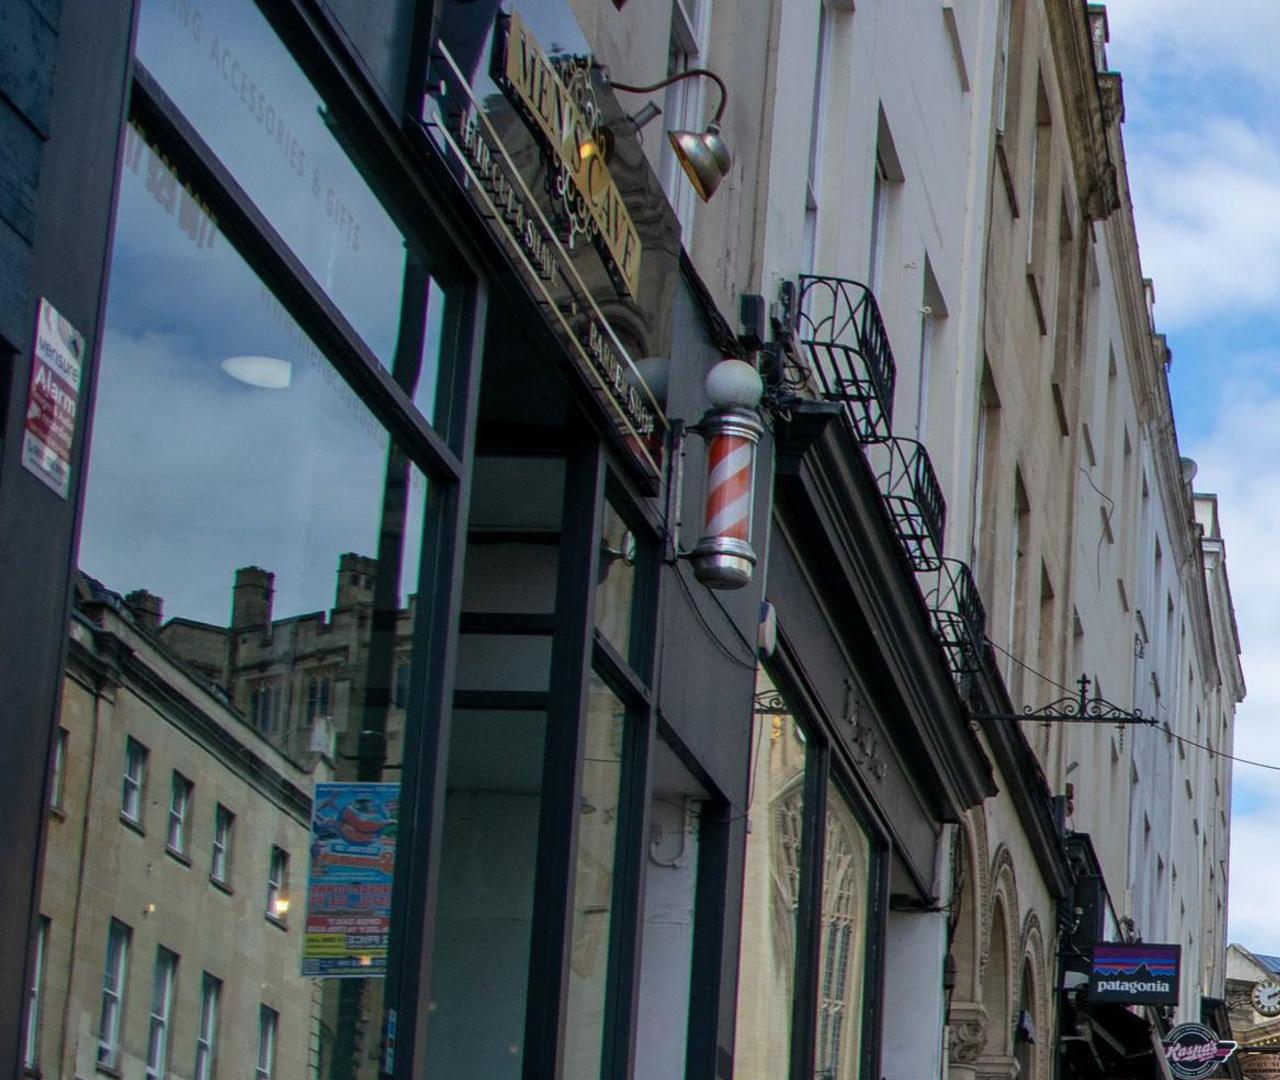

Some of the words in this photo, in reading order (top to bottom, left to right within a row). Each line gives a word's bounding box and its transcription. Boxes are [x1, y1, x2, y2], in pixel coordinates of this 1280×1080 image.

[210, 37, 307, 179] ACCESSORIES
[311, 168, 322, 200] &
[326, 190, 361, 252] GIFTS
[588, 157, 637, 291] CAVE
[38, 336, 80, 384] verisure
[34, 365, 77, 419] Alarm
[1097, 979, 1170, 994] patagonia
[1166, 1039, 1218, 1062] Kaspa's
